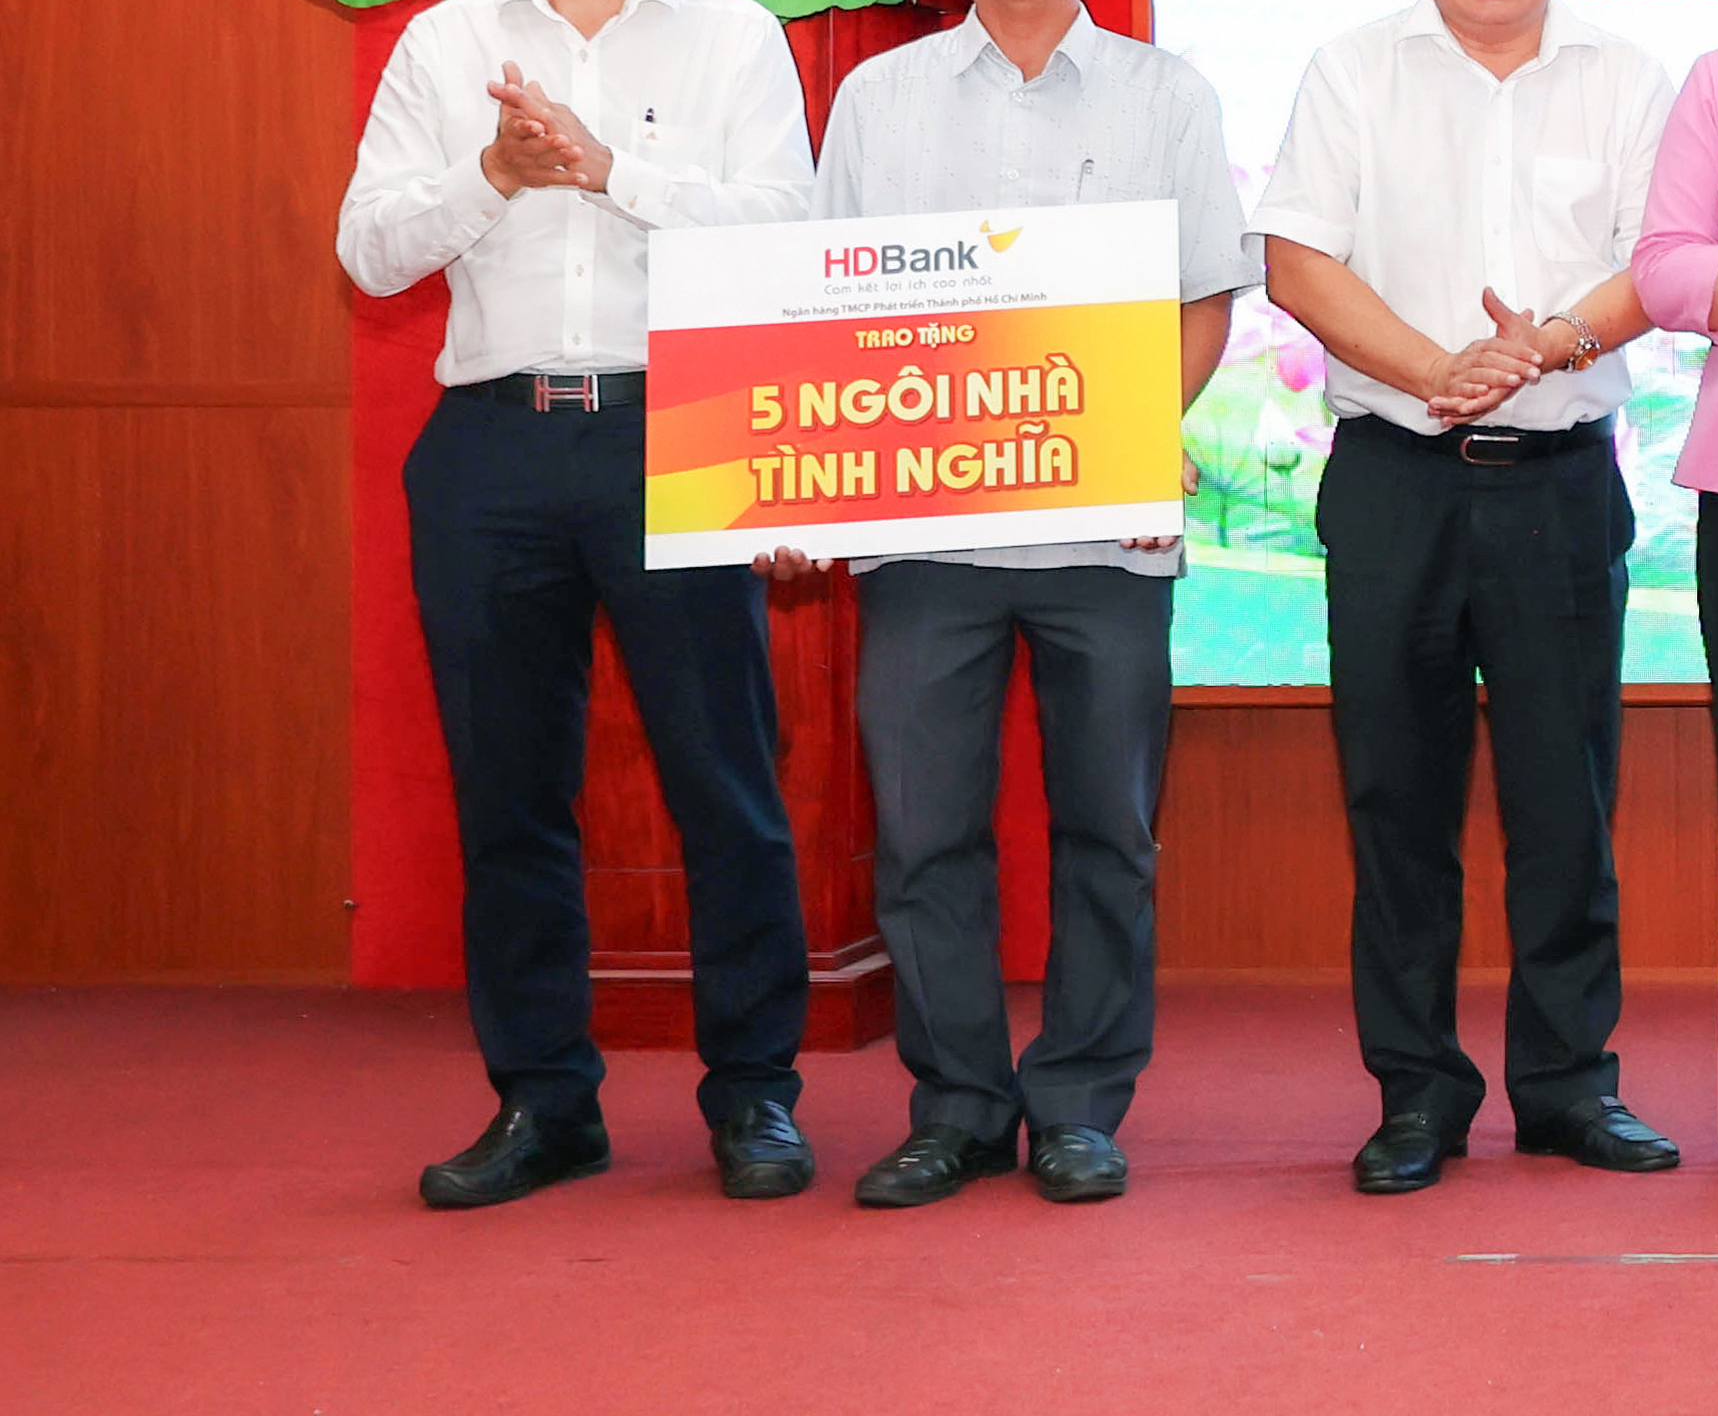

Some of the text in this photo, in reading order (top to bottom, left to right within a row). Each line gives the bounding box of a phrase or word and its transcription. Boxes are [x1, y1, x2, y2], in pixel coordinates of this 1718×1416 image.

[824, 240, 979, 277] HDBank
[855, 323, 976, 349] TRAO TẶNG
[750, 354, 1079, 430] 5 NGÔI NHÀ
[750, 421, 1074, 501] TÌNH NGHĨA
